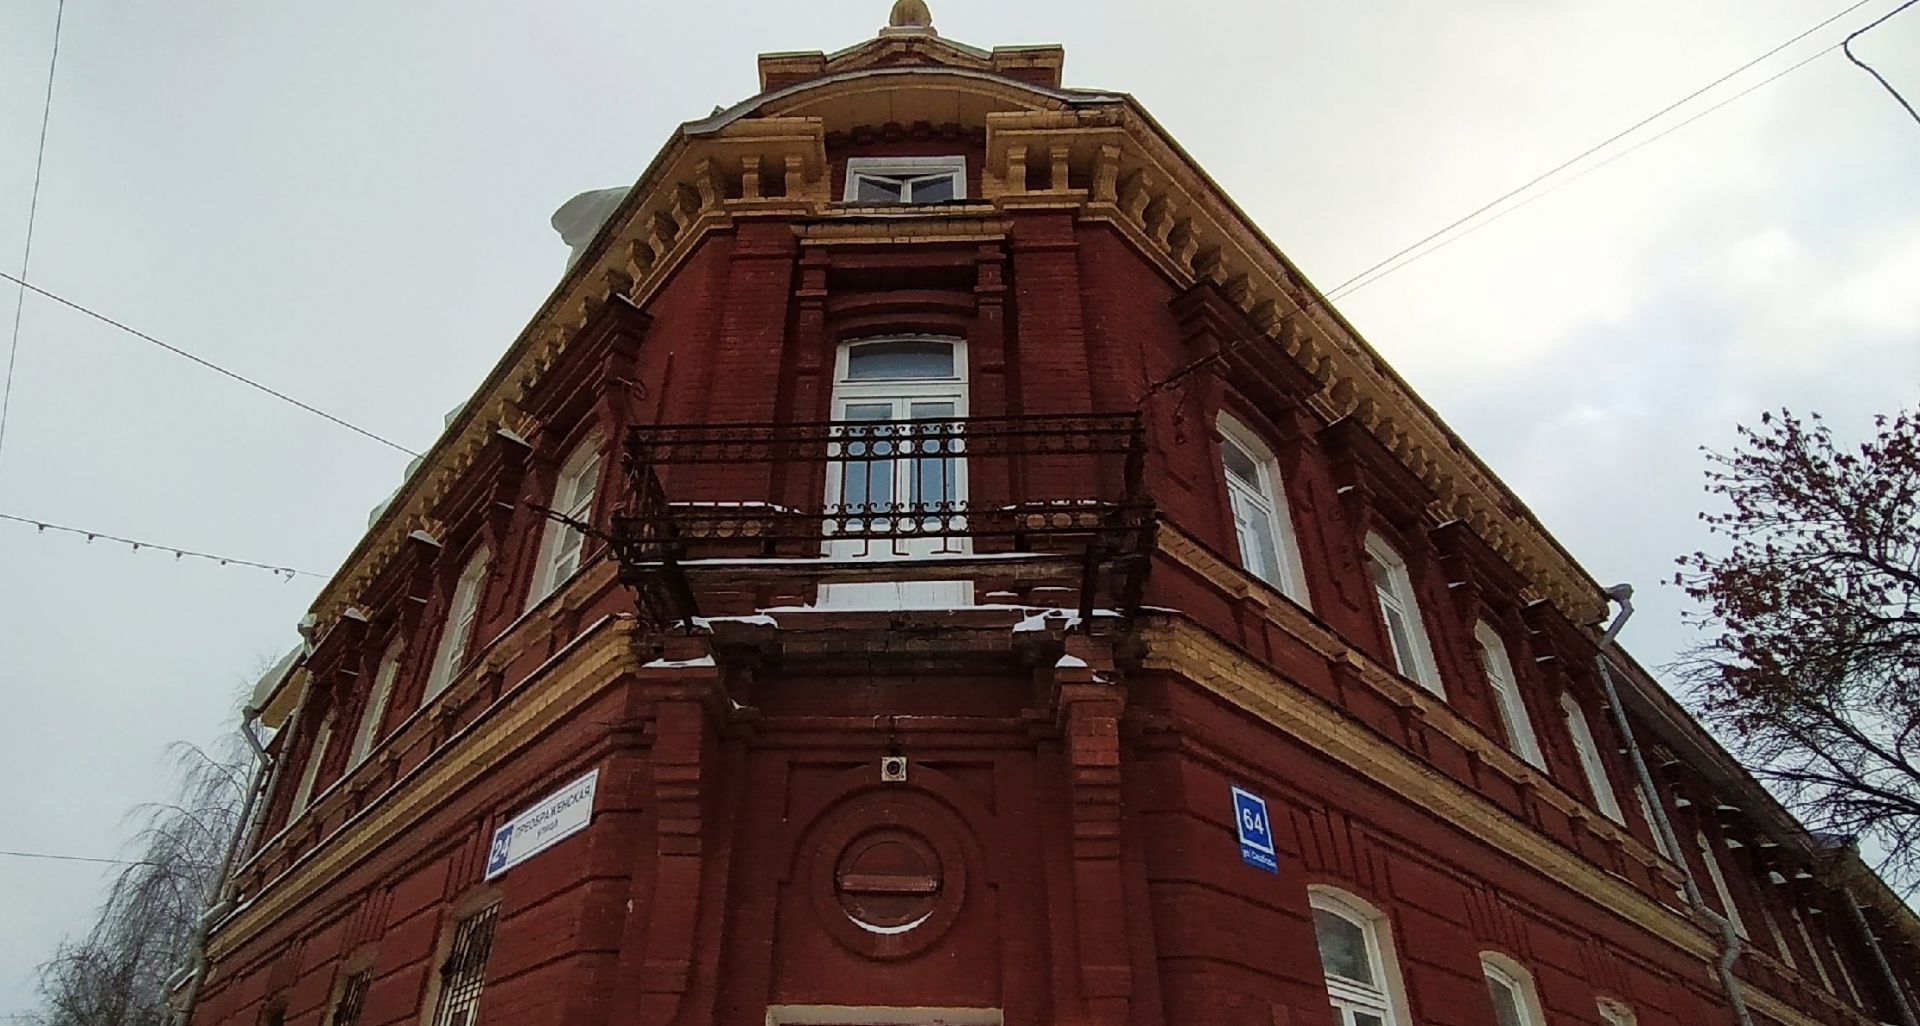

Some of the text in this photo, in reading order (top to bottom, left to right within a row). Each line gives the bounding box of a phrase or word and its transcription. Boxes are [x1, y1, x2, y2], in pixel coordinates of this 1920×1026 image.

[515, 785, 591, 838] ПРЕОБРАЖЕНСКАЯ
[1243, 807, 1264, 834] 64
[491, 836, 510, 863] 24
